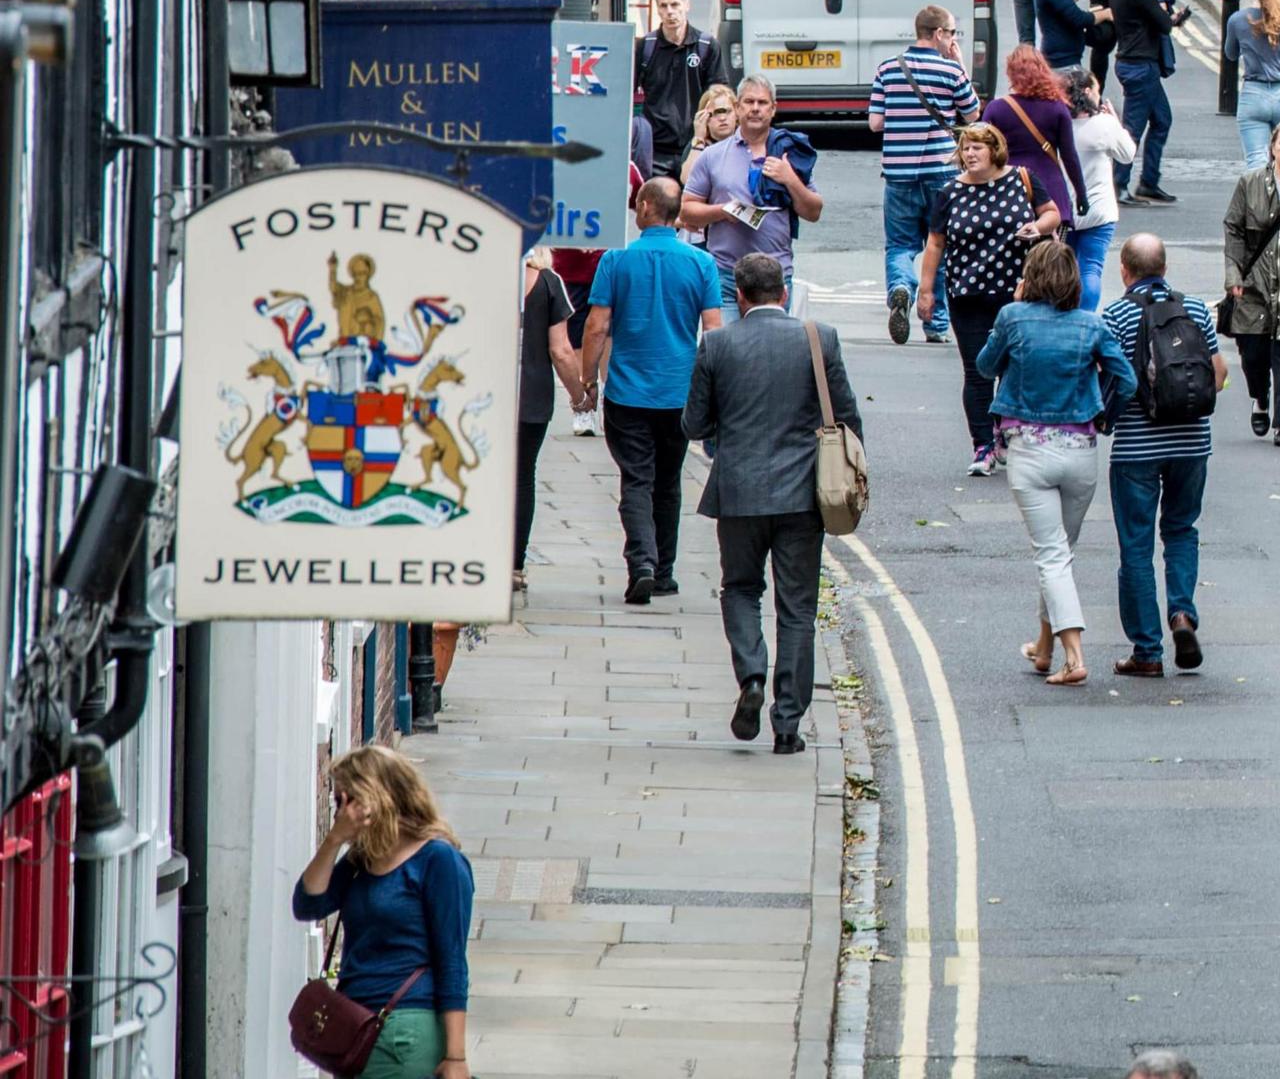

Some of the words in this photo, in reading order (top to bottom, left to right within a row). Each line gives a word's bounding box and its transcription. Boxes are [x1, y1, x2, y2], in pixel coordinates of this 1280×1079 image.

[766, 51, 803, 67] FN60
[808, 51, 835, 67] VPR
[347, 60, 481, 88] MULLEN
[401, 90, 426, 114] &
[230, 200, 485, 254] FOSTERS
[203, 558, 487, 586] JEWELLERS
